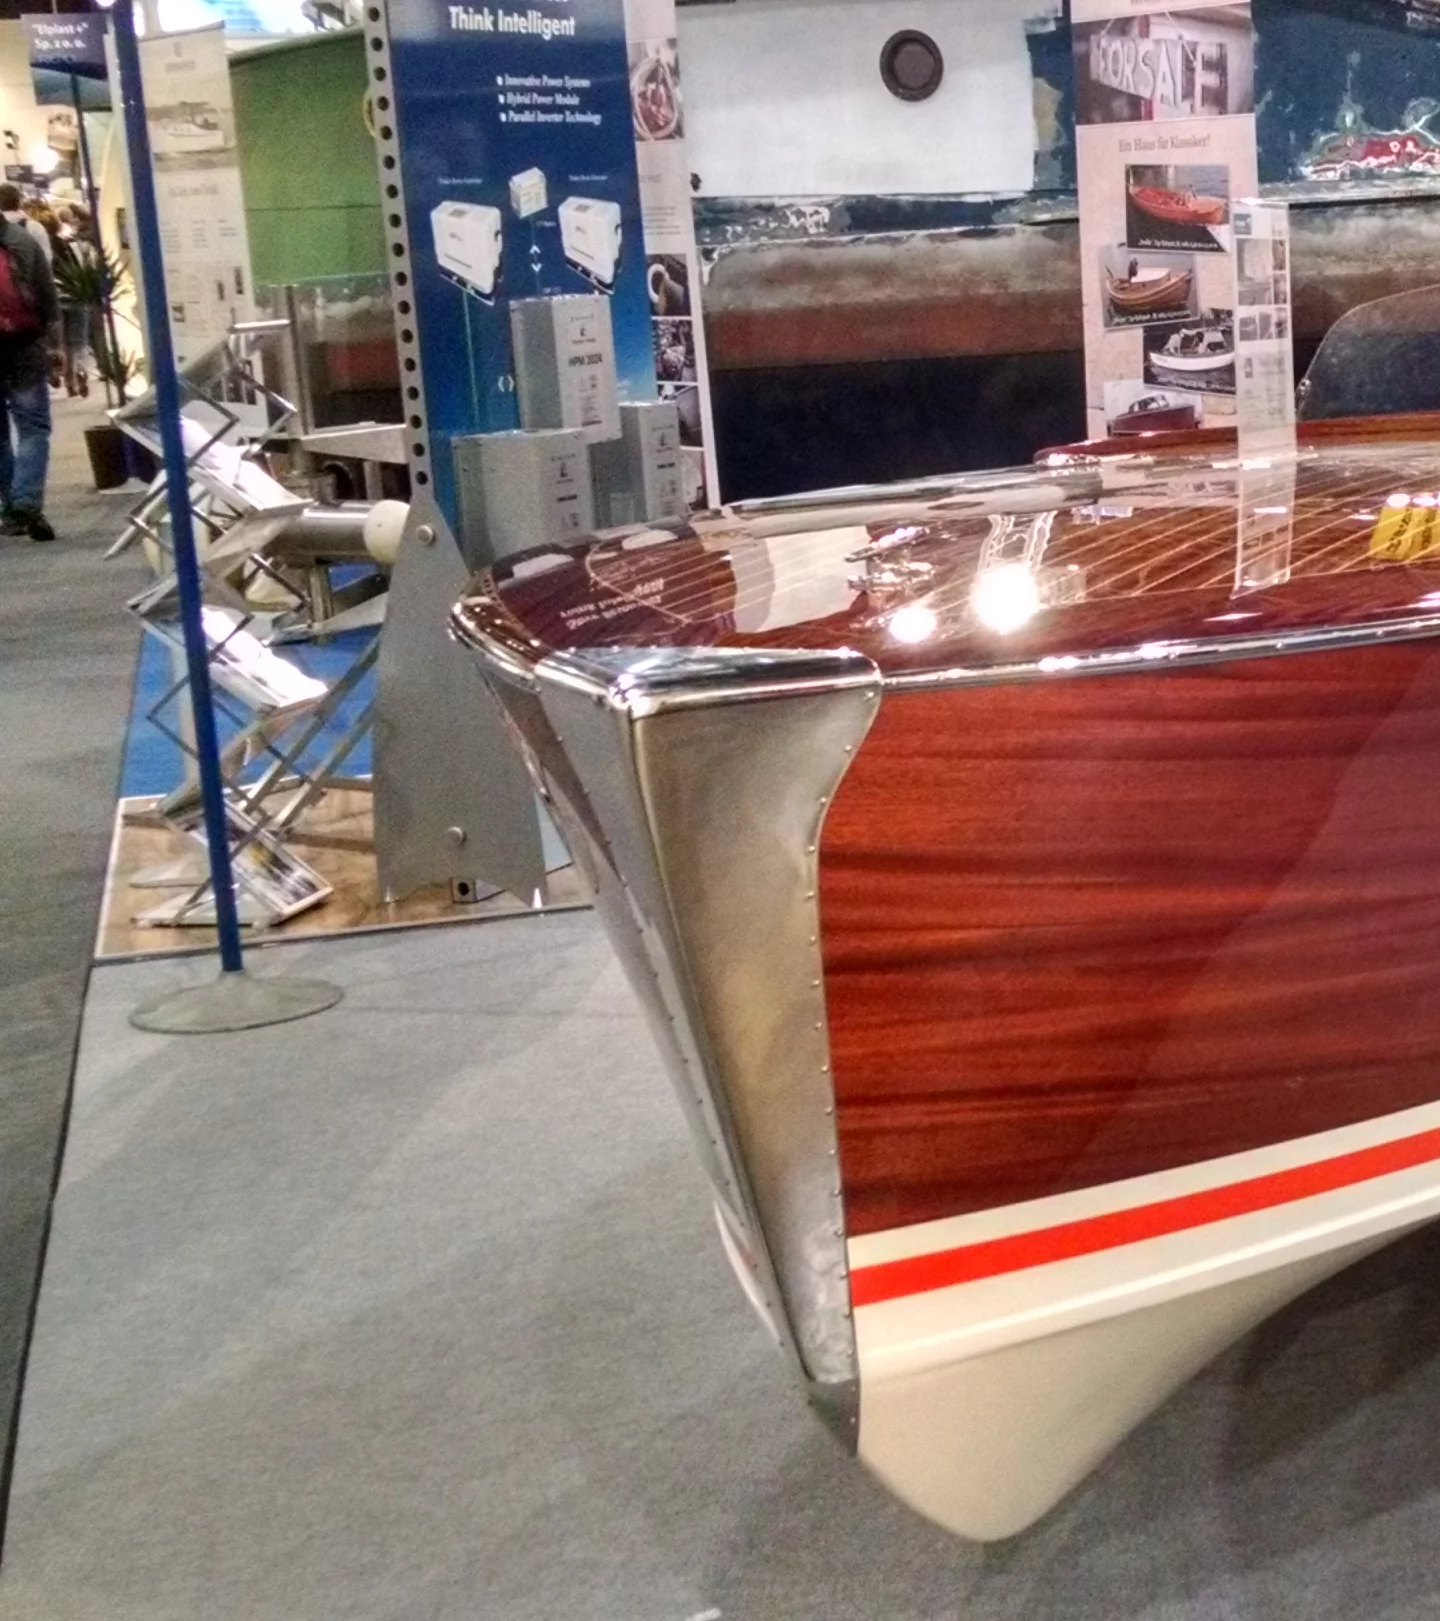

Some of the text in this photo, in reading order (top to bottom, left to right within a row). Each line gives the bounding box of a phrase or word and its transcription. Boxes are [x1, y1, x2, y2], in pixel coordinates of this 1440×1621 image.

[448, 5, 576, 40] Think Intelligent
[542, 75, 563, 87] Power
[563, 75, 591, 90] Systems
[506, 92, 580, 107] Hybrid Power Module
[508, 110, 602, 126] Parallel Inverter Technology
[1118, 134, 1211, 152] Ein Haus für Klassiker!
